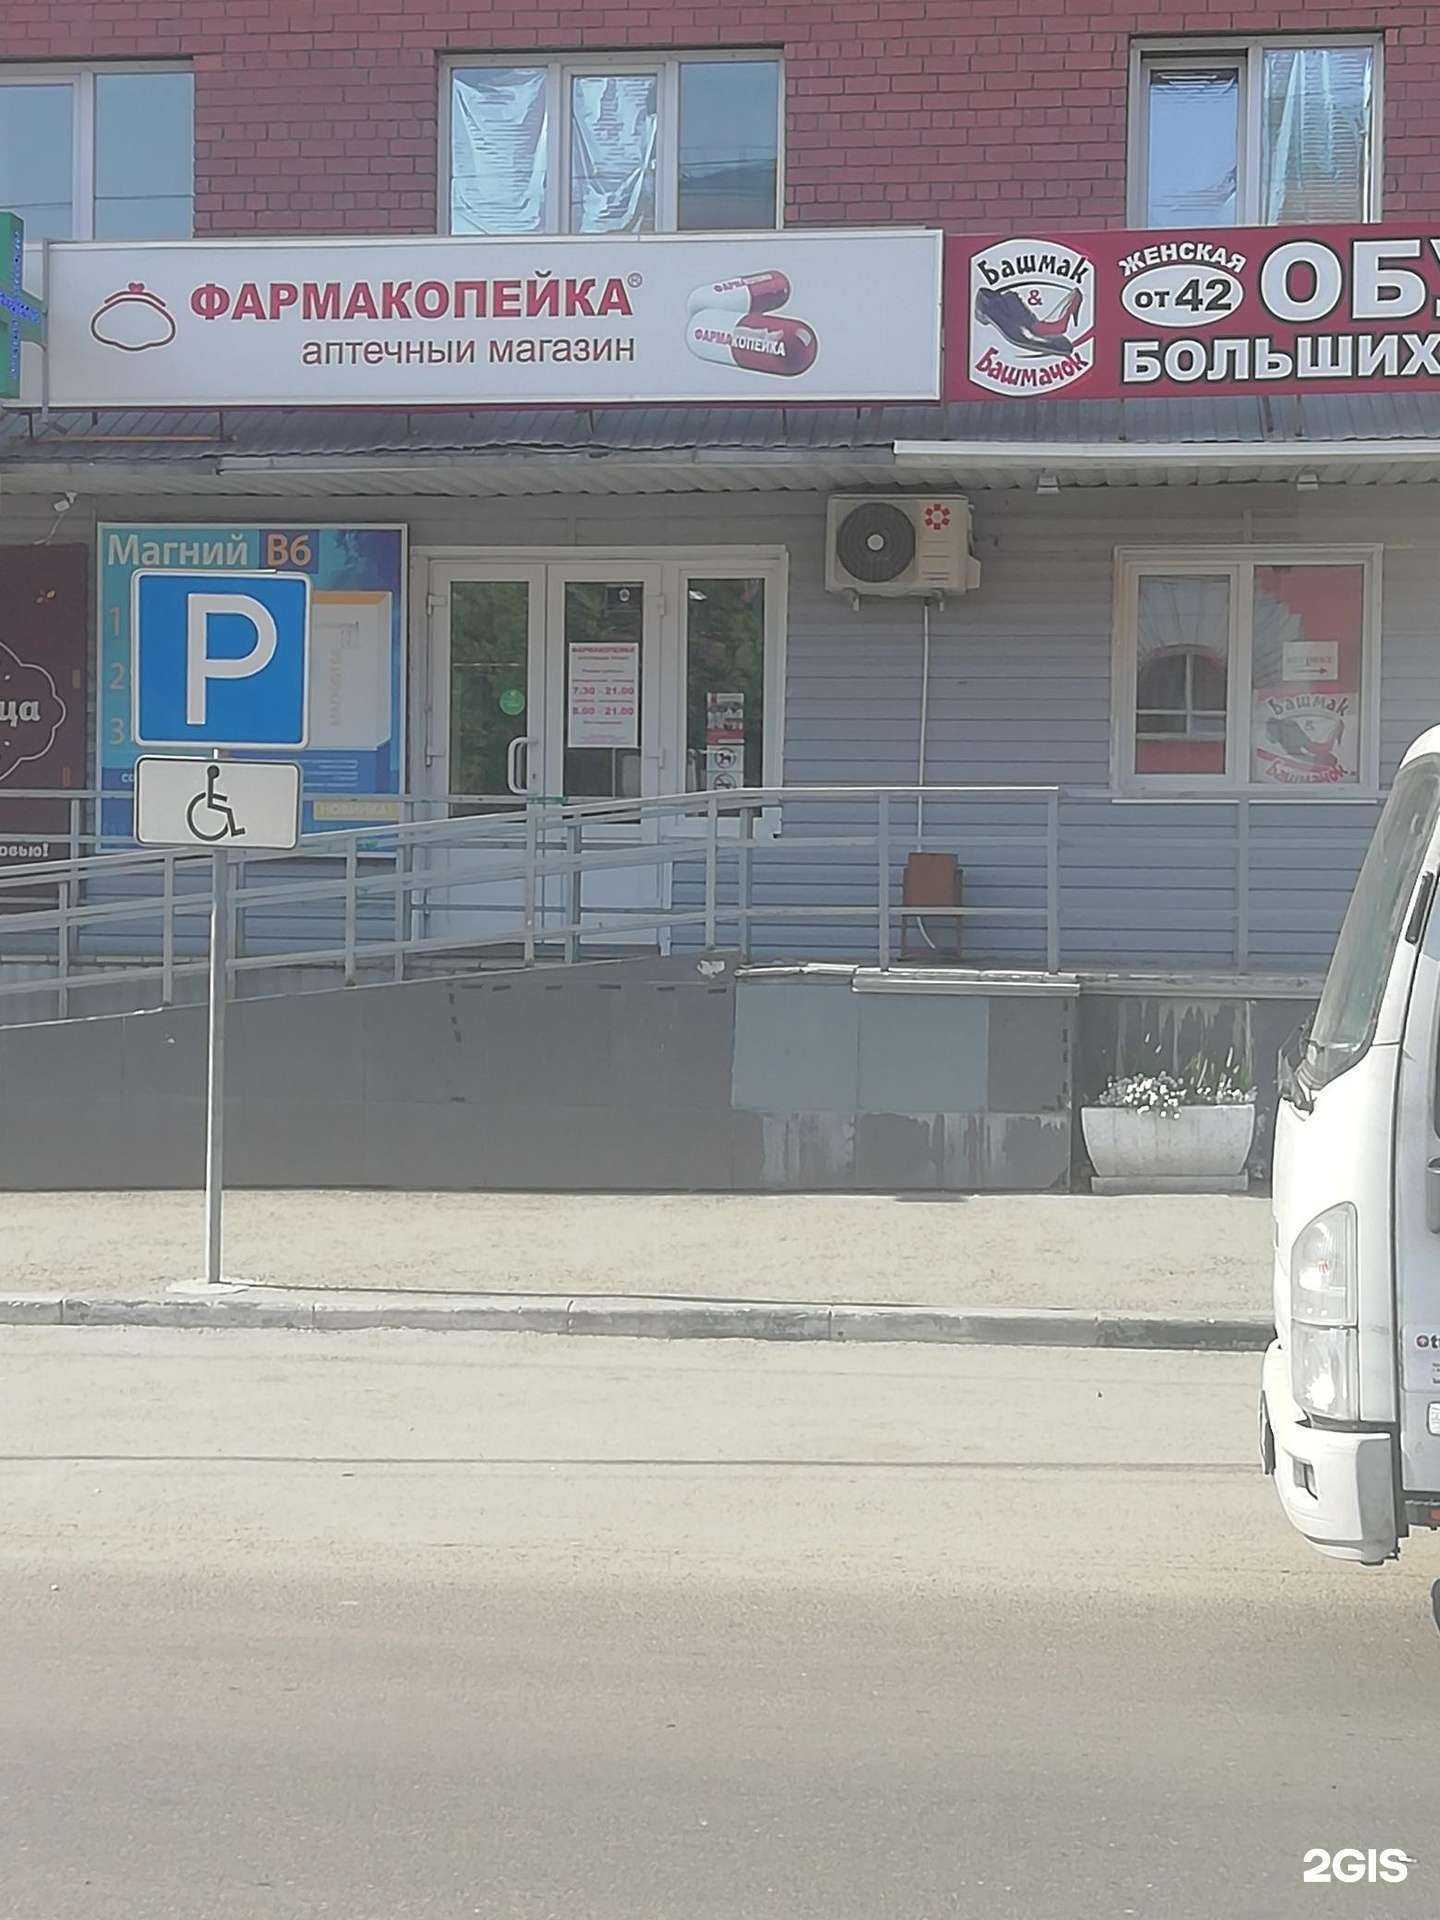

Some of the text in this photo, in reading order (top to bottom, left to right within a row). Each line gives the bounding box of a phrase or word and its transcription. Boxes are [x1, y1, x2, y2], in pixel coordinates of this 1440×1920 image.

[977, 254, 1089, 286] Башмак
[1118, 242, 1247, 276] ЖЕНСКАЯ
[1174, 279, 1232, 312] 42
[489, 336, 636, 364] магазин
[975, 347, 1089, 386] Башмачок
[1123, 334, 1440, 382] БОЛЬШИХ
[107, 533, 248, 566] Магний
[109, 607, 121, 638] 1
[187, 593, 277, 725] P
[110, 662, 125, 690] 2
[110, 717, 125, 745] 3
